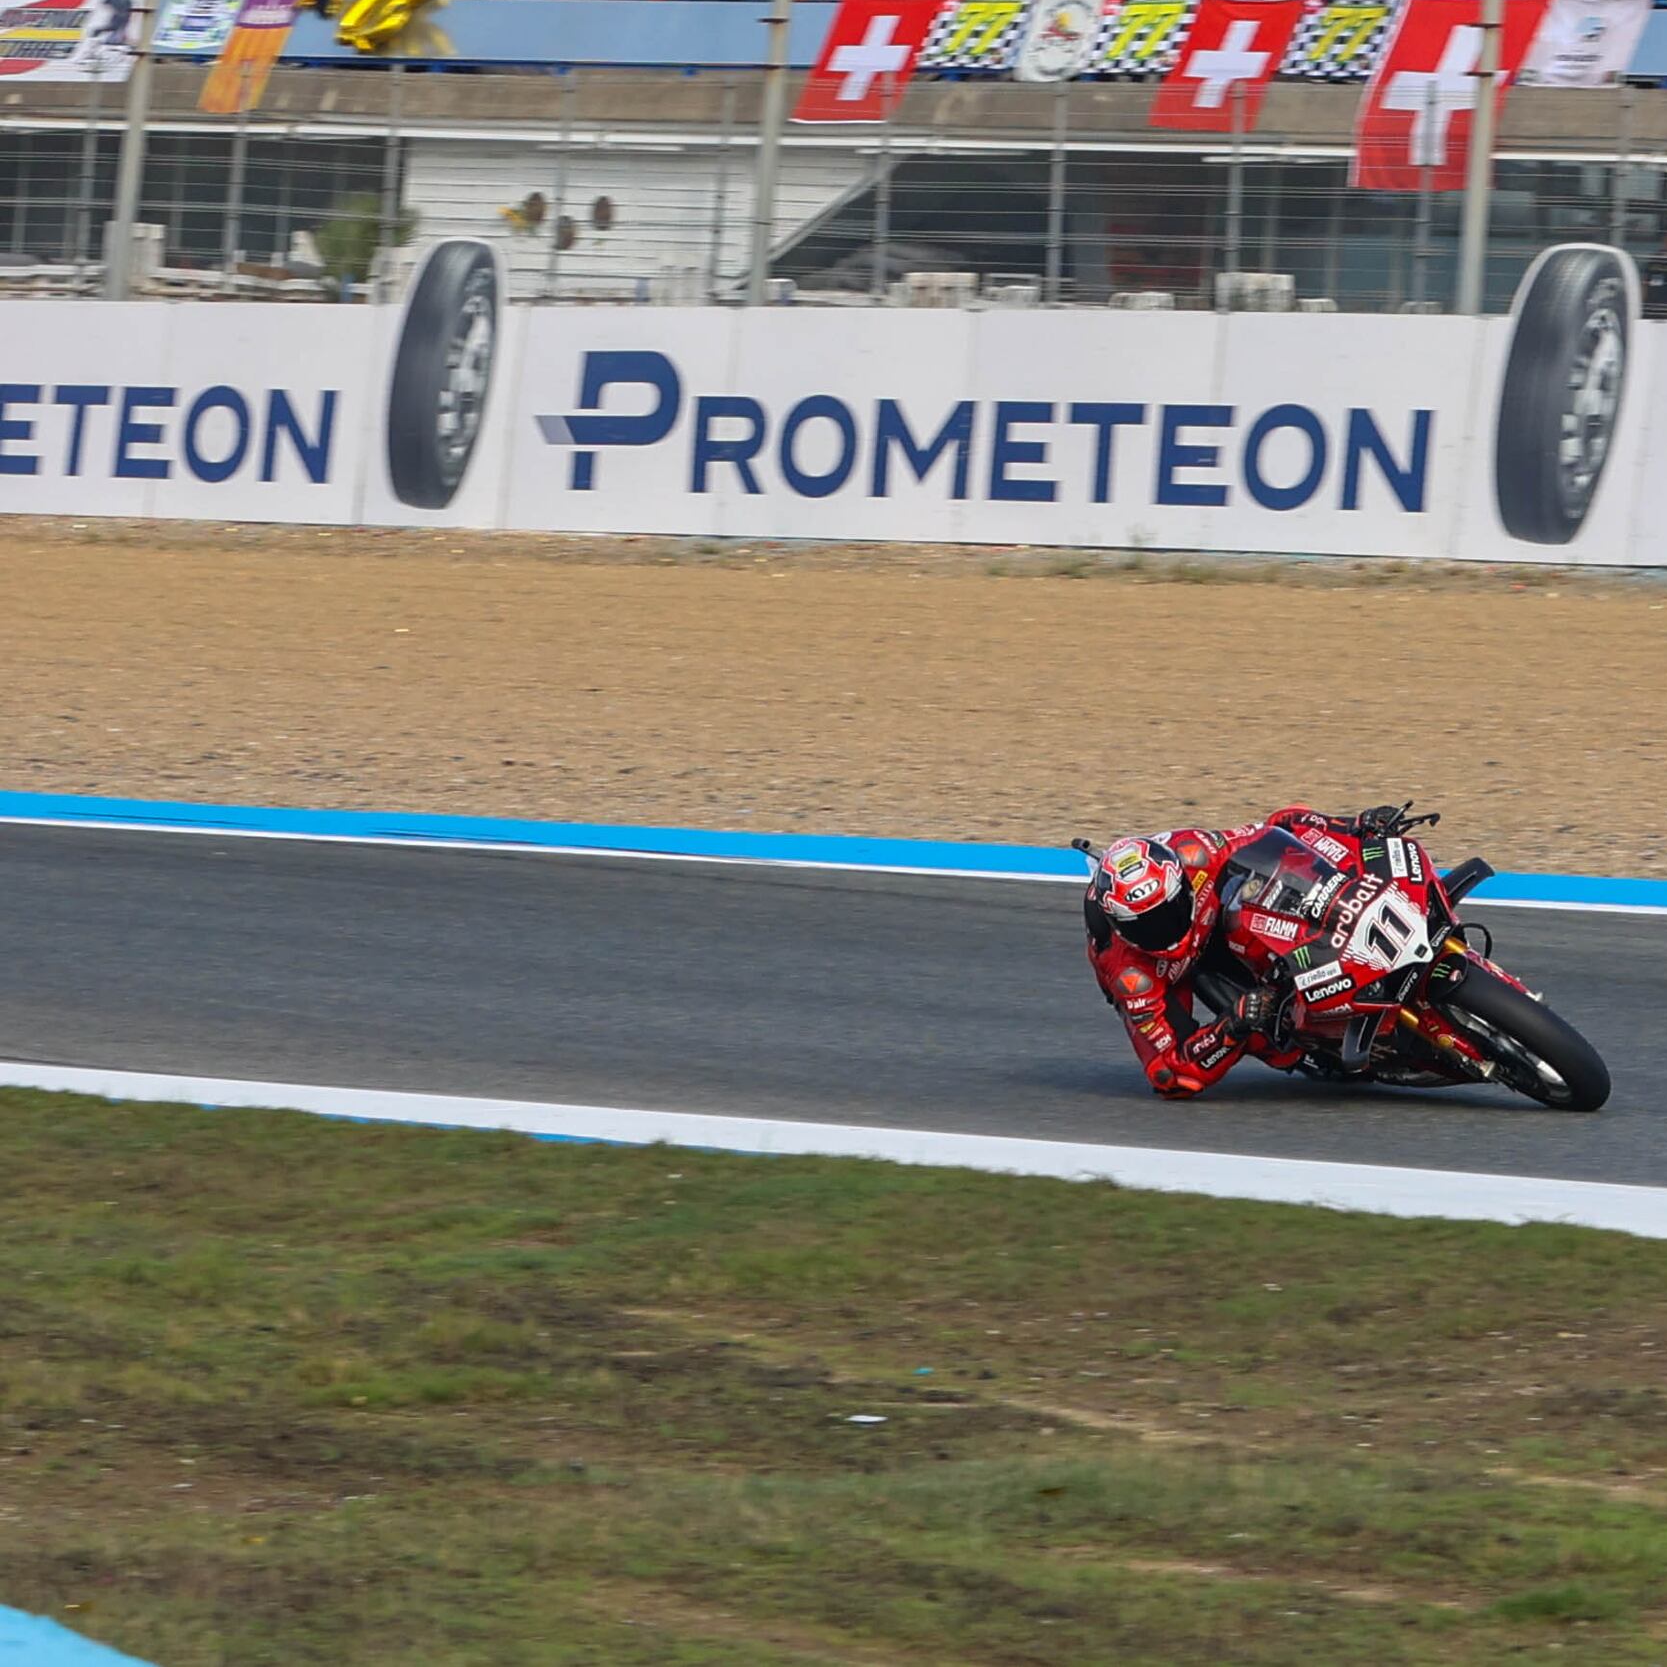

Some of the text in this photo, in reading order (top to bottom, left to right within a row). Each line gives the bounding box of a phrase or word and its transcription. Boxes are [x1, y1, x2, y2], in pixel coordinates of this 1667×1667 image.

[1106, 1, 1187, 60] 77
[1306, 4, 1389, 63] 77
[545, 351, 1431, 523] PROMETEON
[1407, 843, 1423, 882] Lenovo
[1264, 917, 1299, 939] FIAMM
[1366, 902, 1414, 966] 11
[1305, 978, 1353, 1003] Lenovo
